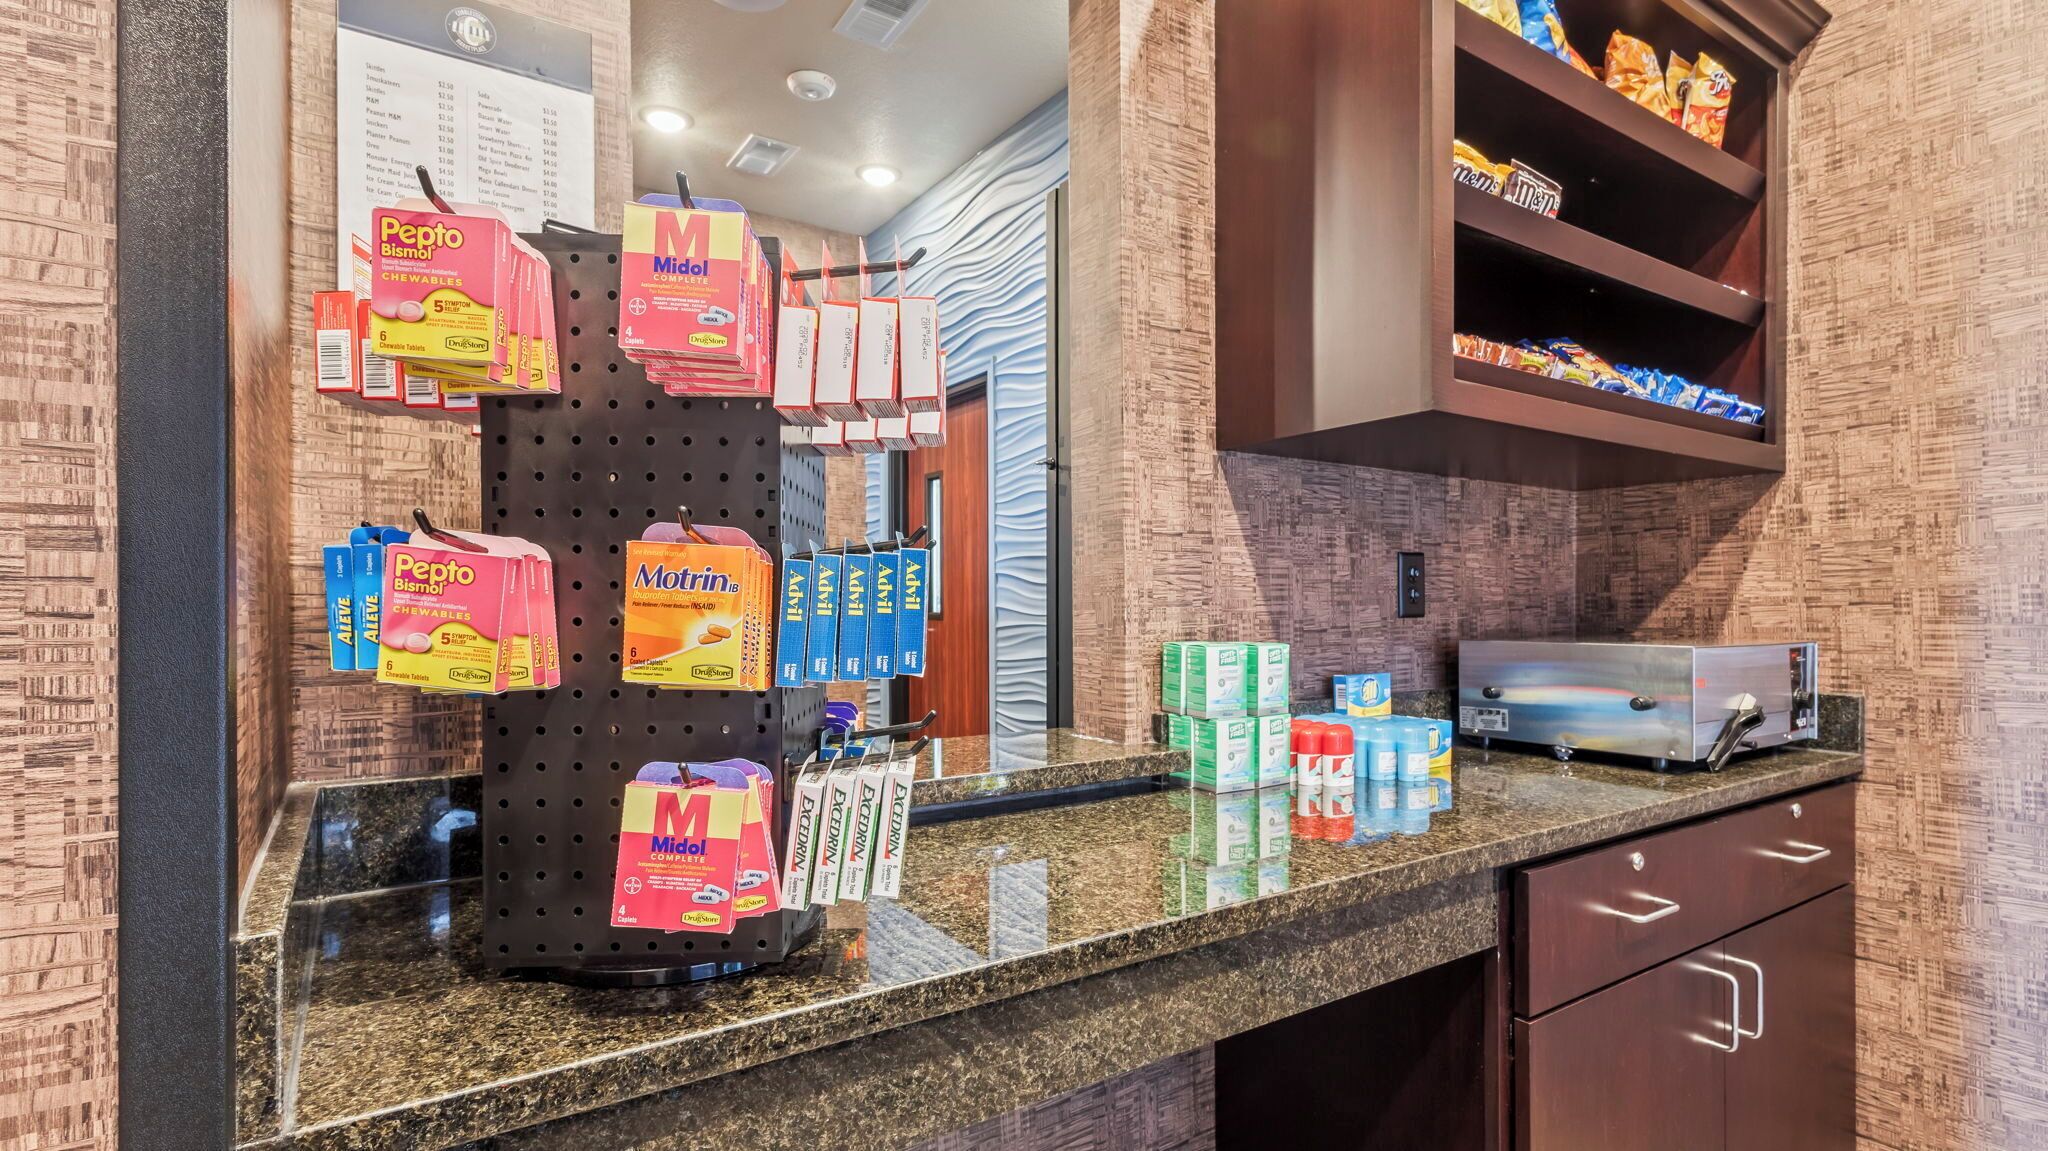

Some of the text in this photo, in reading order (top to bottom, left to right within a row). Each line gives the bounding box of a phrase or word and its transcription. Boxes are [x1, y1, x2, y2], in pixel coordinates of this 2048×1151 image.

[366, 96, 379, 104] M&M
[366, 107, 386, 118] Peanut
[388, 112, 401, 120] M&M
[366, 118, 388, 129] Snickers
[366, 130, 386, 140] Planter
[366, 152, 388, 162] Monster
[366, 164, 385, 173] Minute
[377, 177, 394, 186] Cream
[380, 216, 464, 250] Pepto
[654, 211, 710, 259] M
[380, 242, 434, 261] Bismol
[654, 256, 708, 277] Midol
[382, 272, 463, 286] CHEWABLES
[654, 274, 709, 285] COMPLETE
[434, 300, 444, 313] 5
[380, 330, 386, 341] 6
[625, 326, 632, 336] 4
[380, 342, 425, 352] Chewable Tablets
[448, 340, 486, 350] DrugStore
[625, 337, 644, 345] Caplets
[691, 335, 726, 346] DrugStore
[520, 334, 528, 370] Pepto
[548, 338, 557, 373] Pepto
[664, 551, 686, 559] Warning
[394, 552, 475, 586] Pepto
[634, 563, 739, 593] Motrin IB
[905, 558, 922, 610] Advil
[393, 577, 445, 596] Bismol
[816, 563, 835, 616] Advil
[848, 563, 865, 616] Advil
[877, 562, 894, 614] Advil
[632, 590, 698, 602] Ibuprofen Tablets
[787, 569, 806, 622] Advil
[690, 602, 716, 610] (NSAID)
[364, 595, 379, 644] ALEVE
[393, 605, 471, 621] CHEWABLES
[336, 597, 353, 646] ALEVE
[440, 633, 477, 645] 5 SYMPTOM
[499, 638, 508, 674] Pepto
[534, 632, 544, 668] Pepto
[548, 636, 558, 671] Pepto
[630, 647, 637, 657] 6
[386, 660, 393, 670] 6
[385, 671, 429, 681] Chewable Tablets
[452, 671, 488, 682] DrugStore
[694, 668, 731, 678] DrugStore
[653, 791, 711, 836] M
[888, 782, 907, 857] EXCEDRIN
[826, 787, 846, 864] EXCEDRIN
[854, 783, 875, 860] EXCEDRIN
[795, 795, 814, 870] EXCEDRIN
[652, 836, 706, 855] Midol
[650, 854, 705, 863] COMPLETE
[618, 904, 625, 914] 4
[617, 915, 637, 924] Caplets
[684, 914, 719, 925] DrugStore
